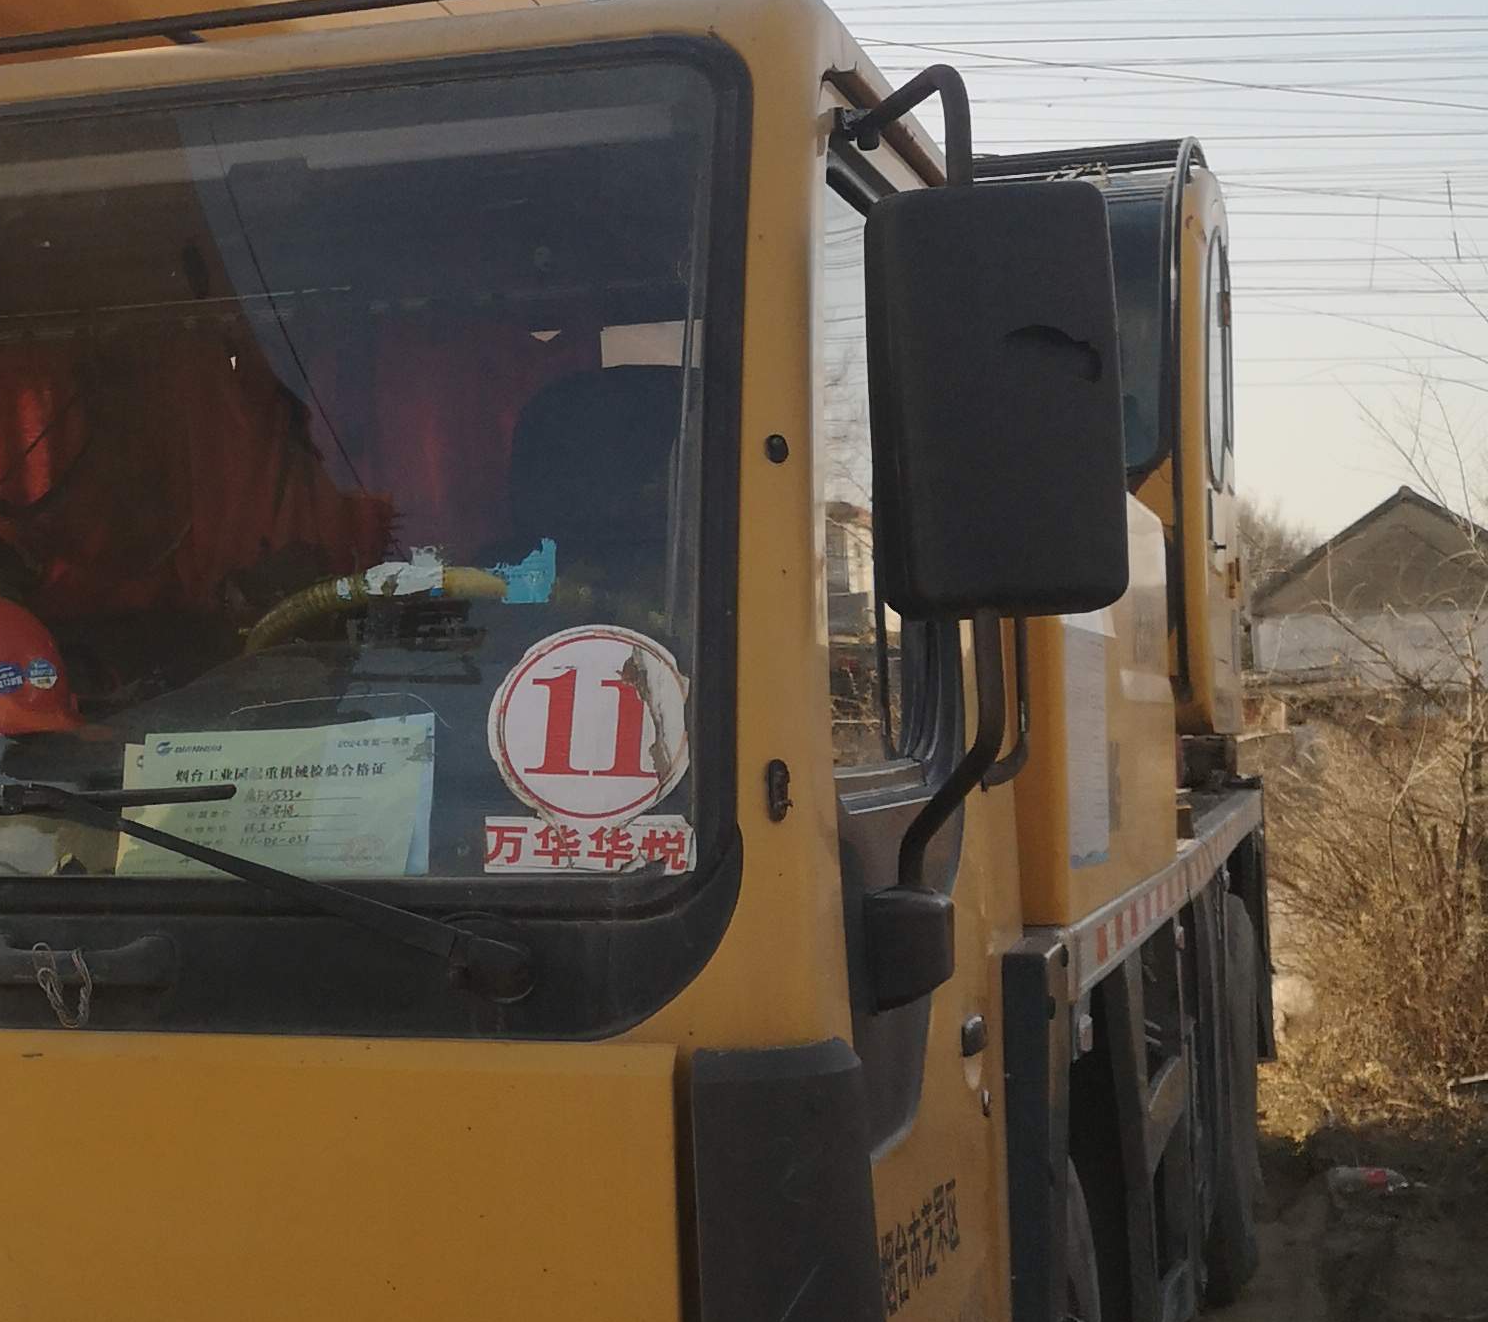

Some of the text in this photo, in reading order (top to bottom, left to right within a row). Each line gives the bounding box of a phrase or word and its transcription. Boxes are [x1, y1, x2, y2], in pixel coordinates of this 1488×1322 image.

[524, 668, 658, 778] 11
[486, 824, 688, 871] 万华华悦
